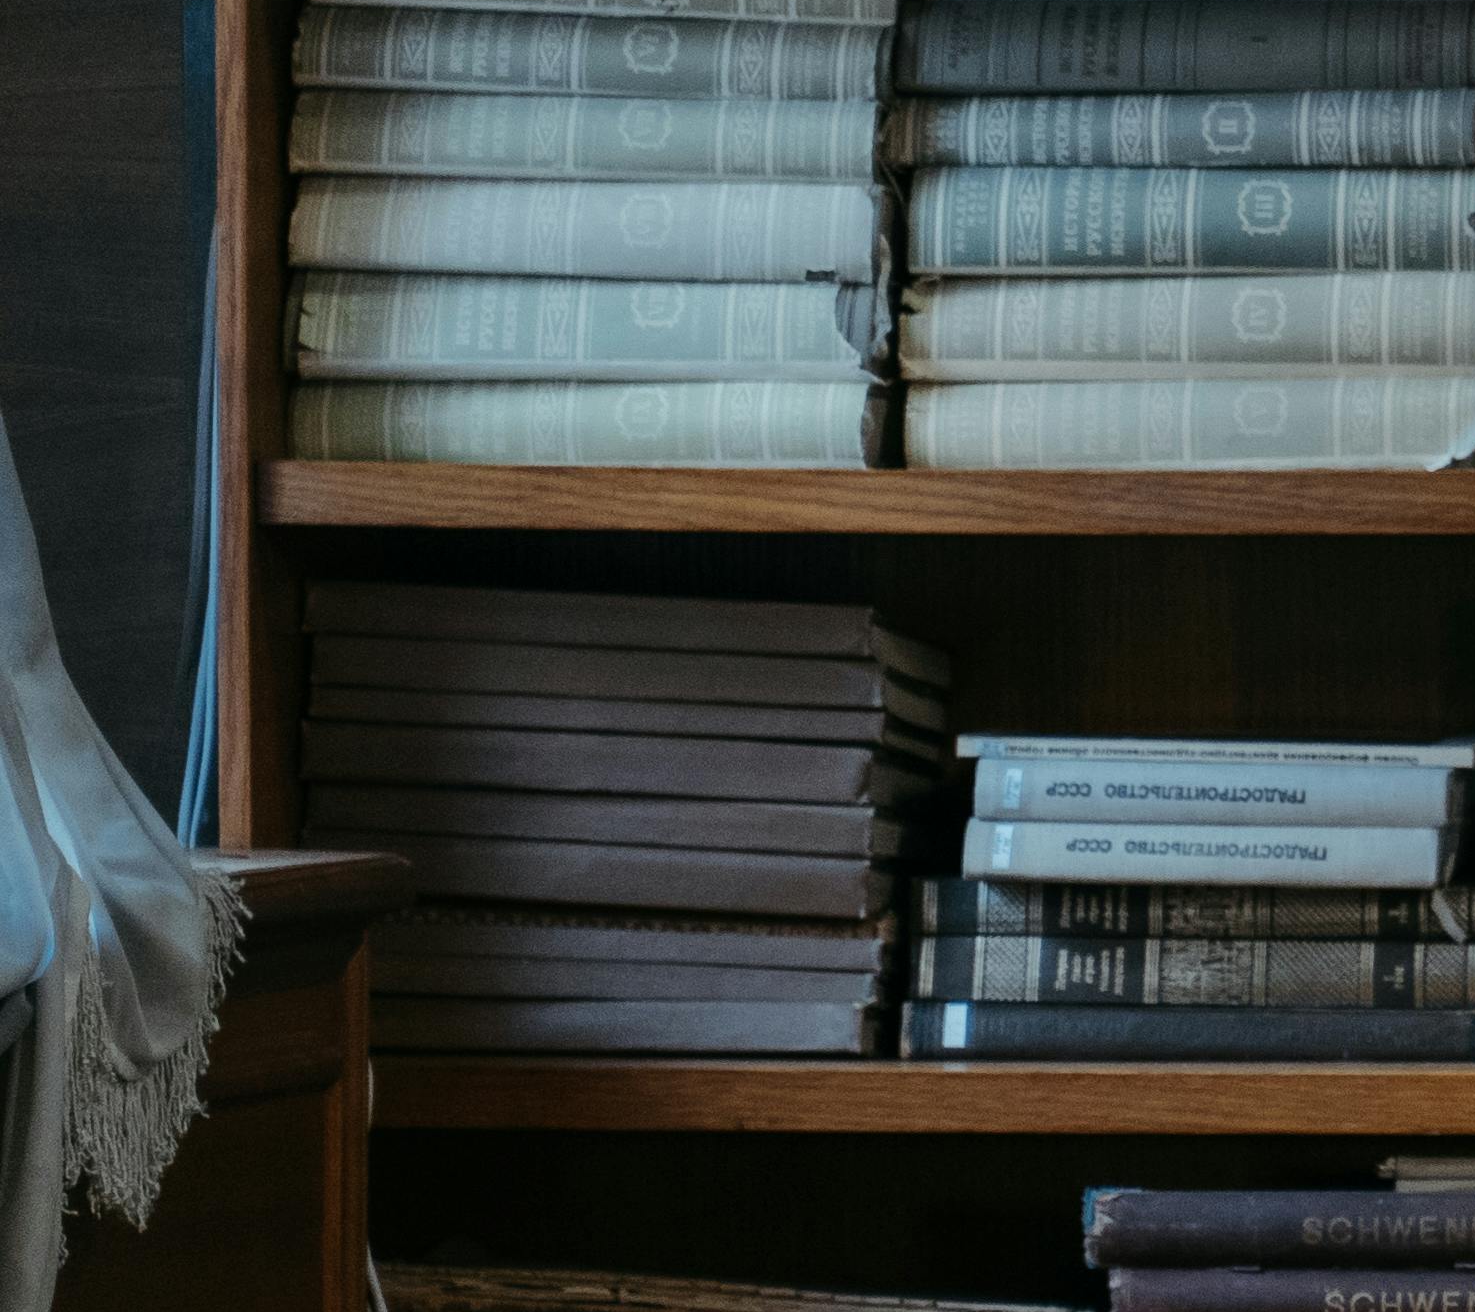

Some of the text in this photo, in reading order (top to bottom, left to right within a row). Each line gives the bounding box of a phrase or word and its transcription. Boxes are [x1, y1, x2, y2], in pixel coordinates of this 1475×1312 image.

[1045, 782, 1307, 804] ГРАДОСТРОИТЕЛЬСТВО СССР
[1065, 839, 1328, 862] ГРАДОСТРОИТЕЛЬСТВО СССР
